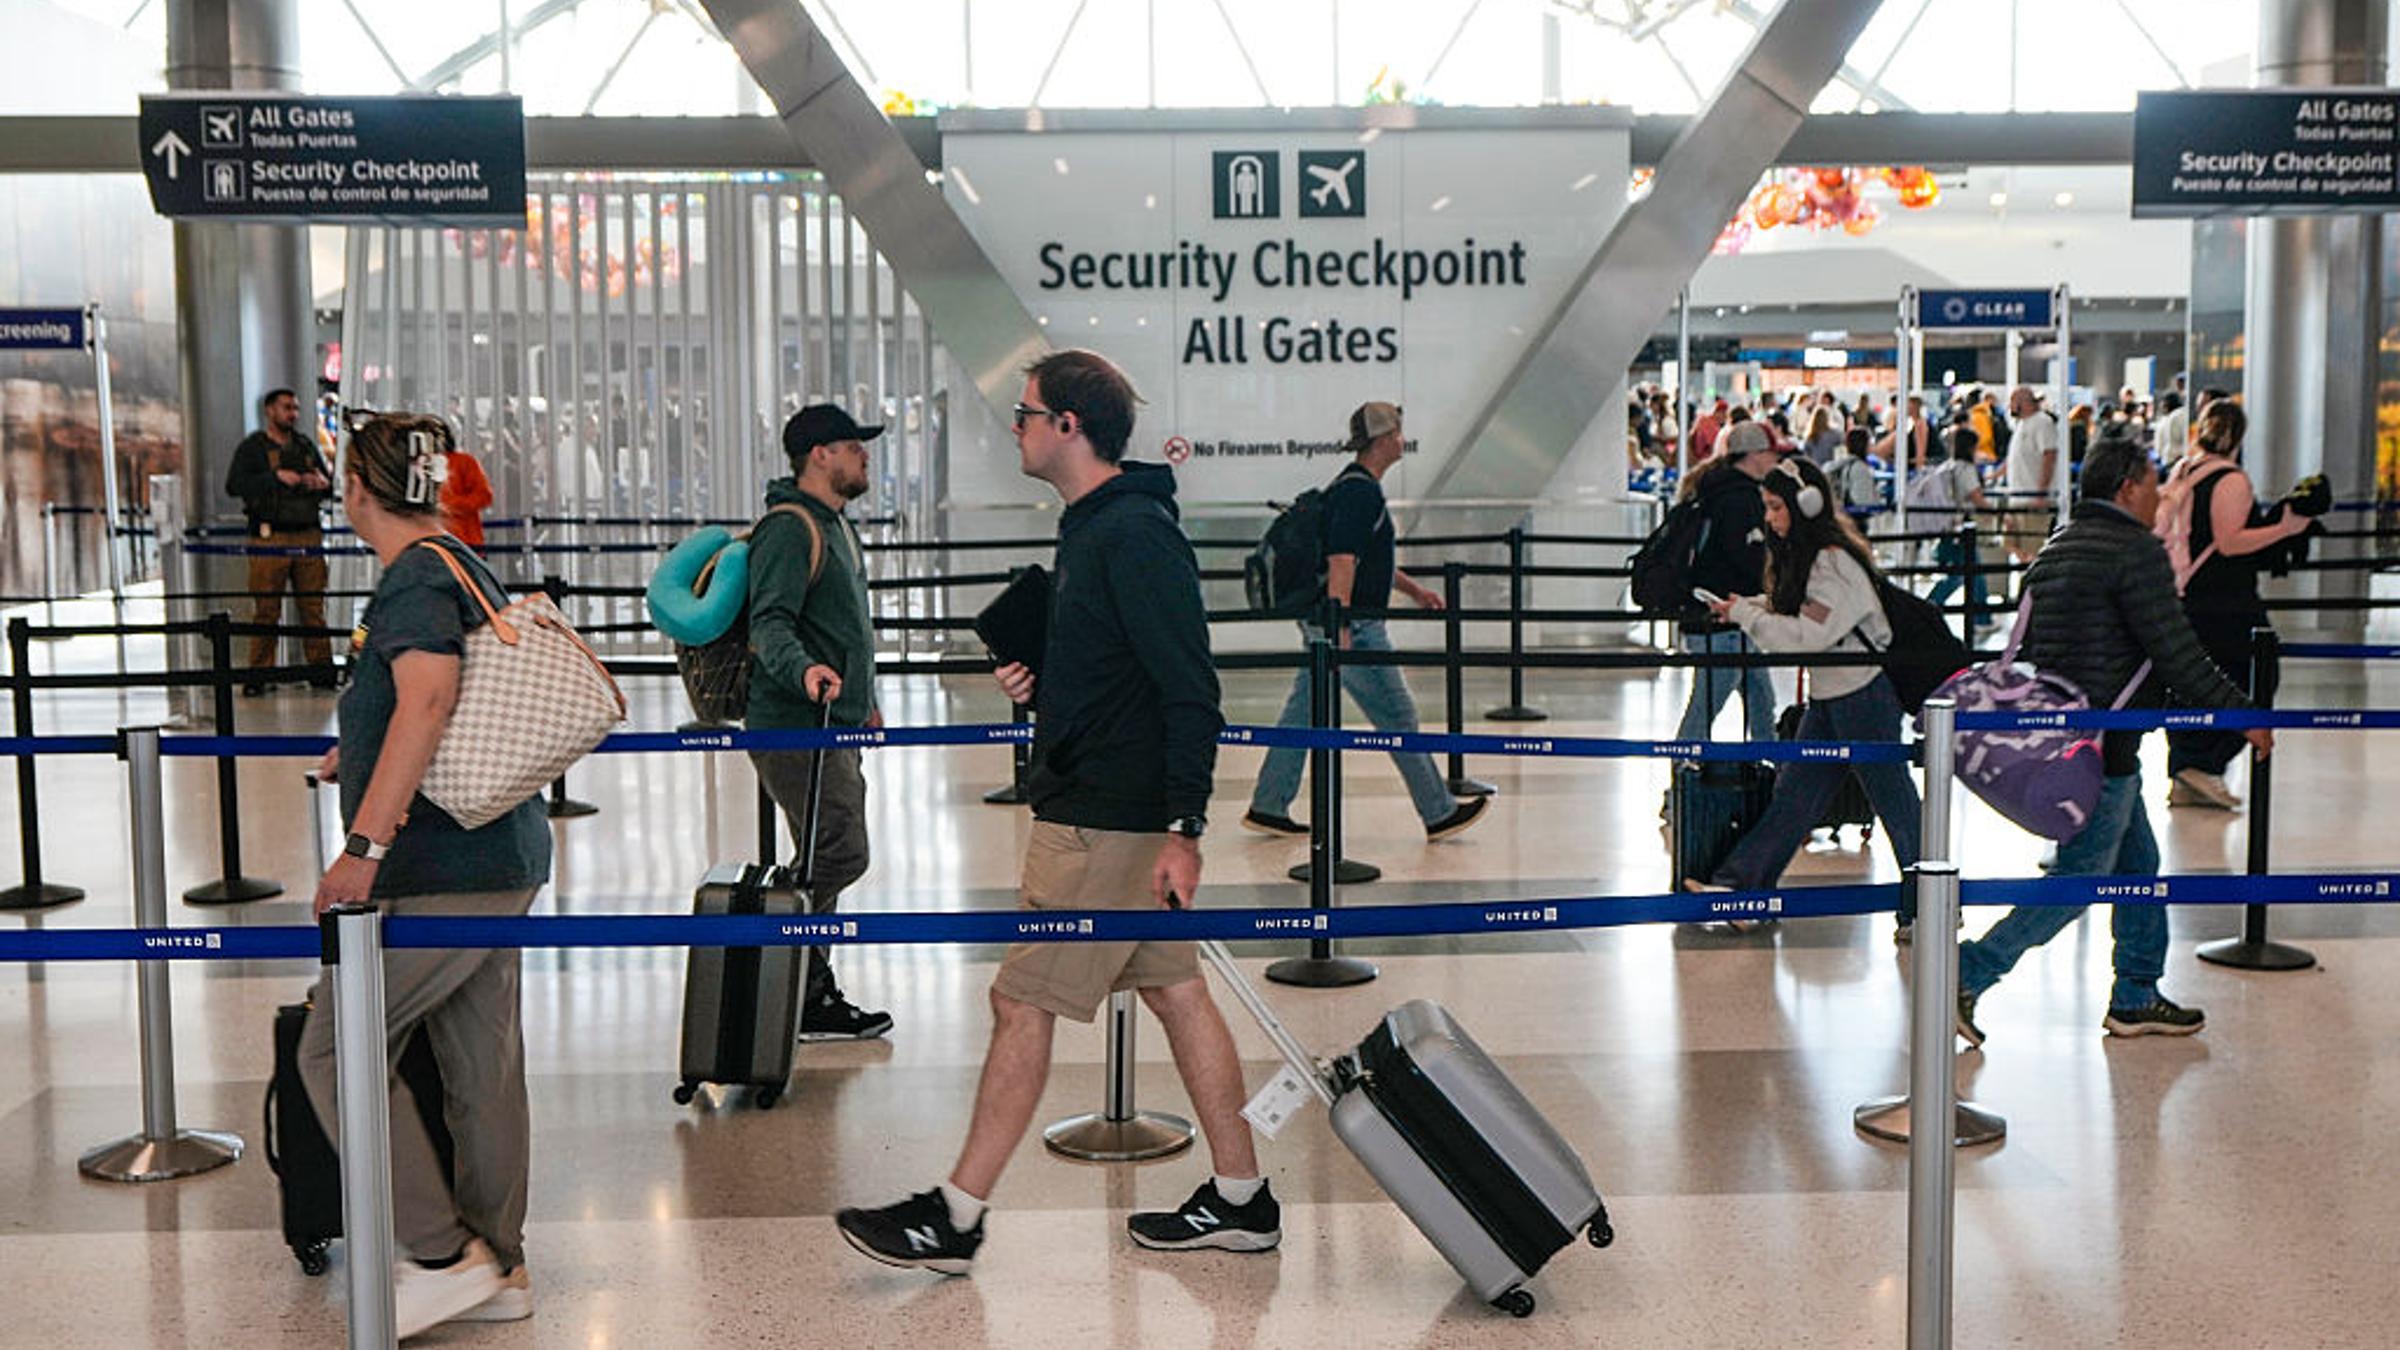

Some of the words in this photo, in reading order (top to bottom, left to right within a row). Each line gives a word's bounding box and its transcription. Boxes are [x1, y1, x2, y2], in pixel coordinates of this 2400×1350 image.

[250, 106, 282, 128] All
[287, 107, 354, 128] Gates
[2297, 100, 2327, 121] All
[2333, 101, 2394, 121] Gates
[2295, 125, 2335, 140] Todas
[2339, 126, 2393, 140] Puertas
[250, 133, 294, 147] Todas
[299, 133, 357, 148] Puertas
[2180, 151, 2268, 176] Security
[2273, 151, 2393, 176] Checkpoint
[252, 160, 345, 185] Security
[352, 159, 481, 185] Checkpoint
[2172, 177, 2222, 191] Puesto
[2225, 177, 2243, 191] de
[2246, 177, 2297, 191] control
[2301, 177, 2318, 191] de
[2321, 177, 2393, 195] seguridad
[253, 186, 305, 200] Puesto
[308, 186, 328, 200] de
[332, 186, 387, 200] control
[391, 186, 410, 200] de
[414, 186, 489, 204] seguridad
[1039, 241, 1237, 302] Security
[1253, 238, 1527, 300] Checkpoint
[1182, 315, 1248, 364] All
[1262, 317, 1398, 364] Gates
[1194, 440, 1215, 457] No
[1218, 440, 1282, 456] Firearms
[1286, 439, 1342, 460] Beyond
[2096, 885, 2152, 897] UNITED
[2318, 884, 2373, 895] UNITED
[1711, 899, 1765, 912] UNITED
[1485, 909, 1541, 922] UNITED
[782, 924, 840, 936] UNITED
[1018, 921, 1077, 933] UNITED
[1255, 918, 1311, 930] UNITED
[145, 936, 204, 947] UNITED
